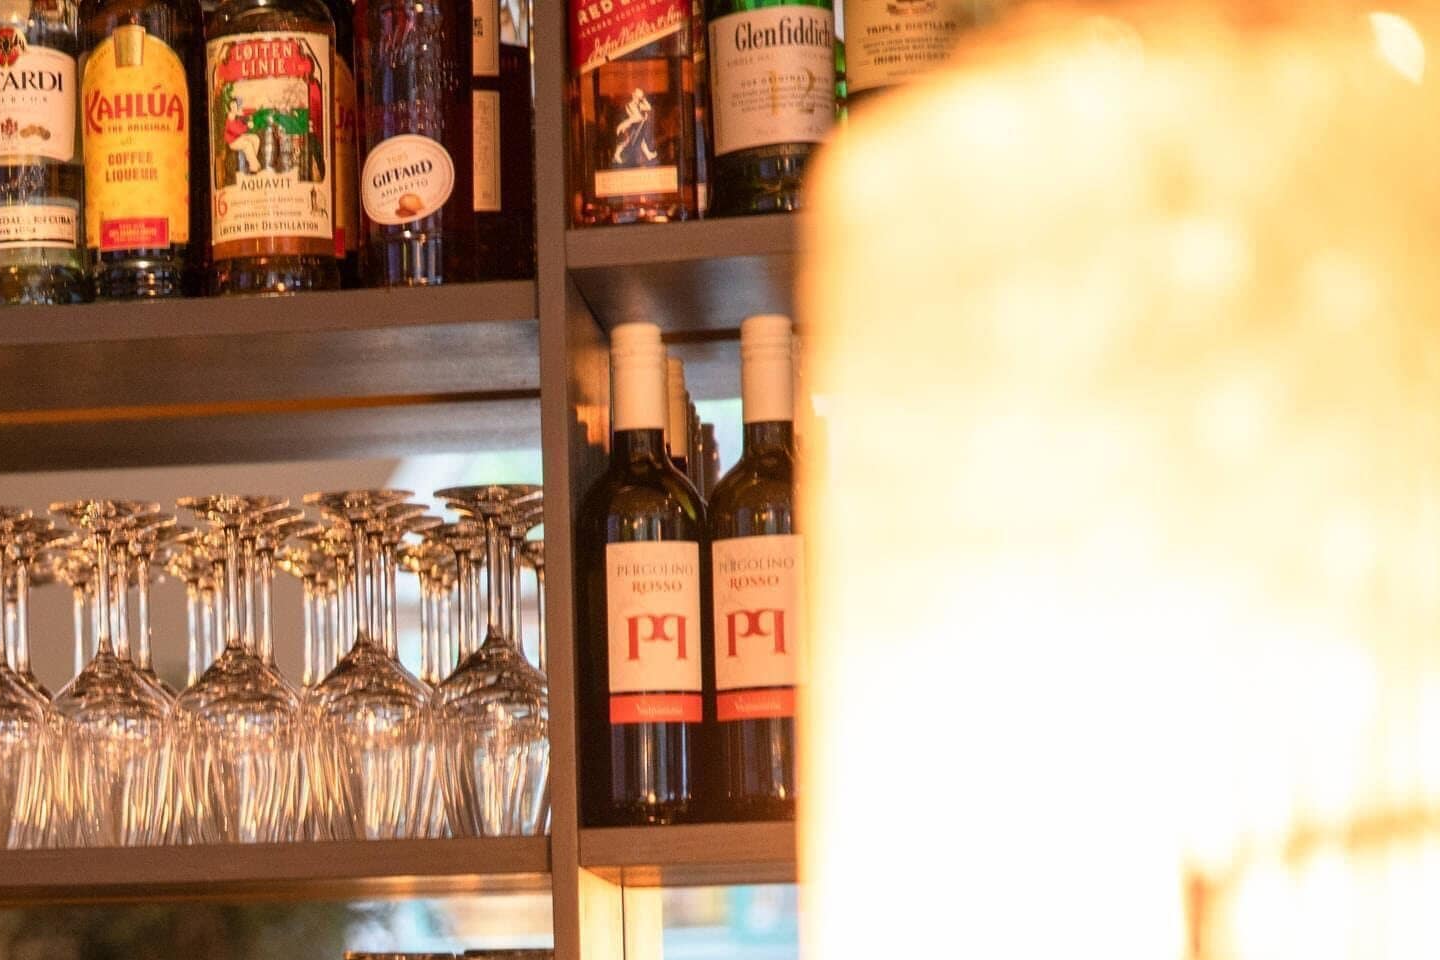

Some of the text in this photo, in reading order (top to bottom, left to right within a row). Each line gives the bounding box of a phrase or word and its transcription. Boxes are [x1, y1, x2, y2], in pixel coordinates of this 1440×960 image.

[577, 0, 613, 26] RED
[734, 17, 832, 52] Glenfiddich
[241, 57, 286, 77] LINIE
[84, 83, 184, 136] KAHLÚA
[108, 151, 153, 167] COFFEE
[105, 167, 158, 183] LIQUEUR
[372, 158, 433, 189] GIFFARD
[240, 177, 291, 191] AQUAVIT
[616, 563, 694, 578] PERGOLINO
[719, 555, 795, 574] PERGOLINO
[631, 580, 683, 595] ROSSO
[729, 575, 780, 592] ROSSO
